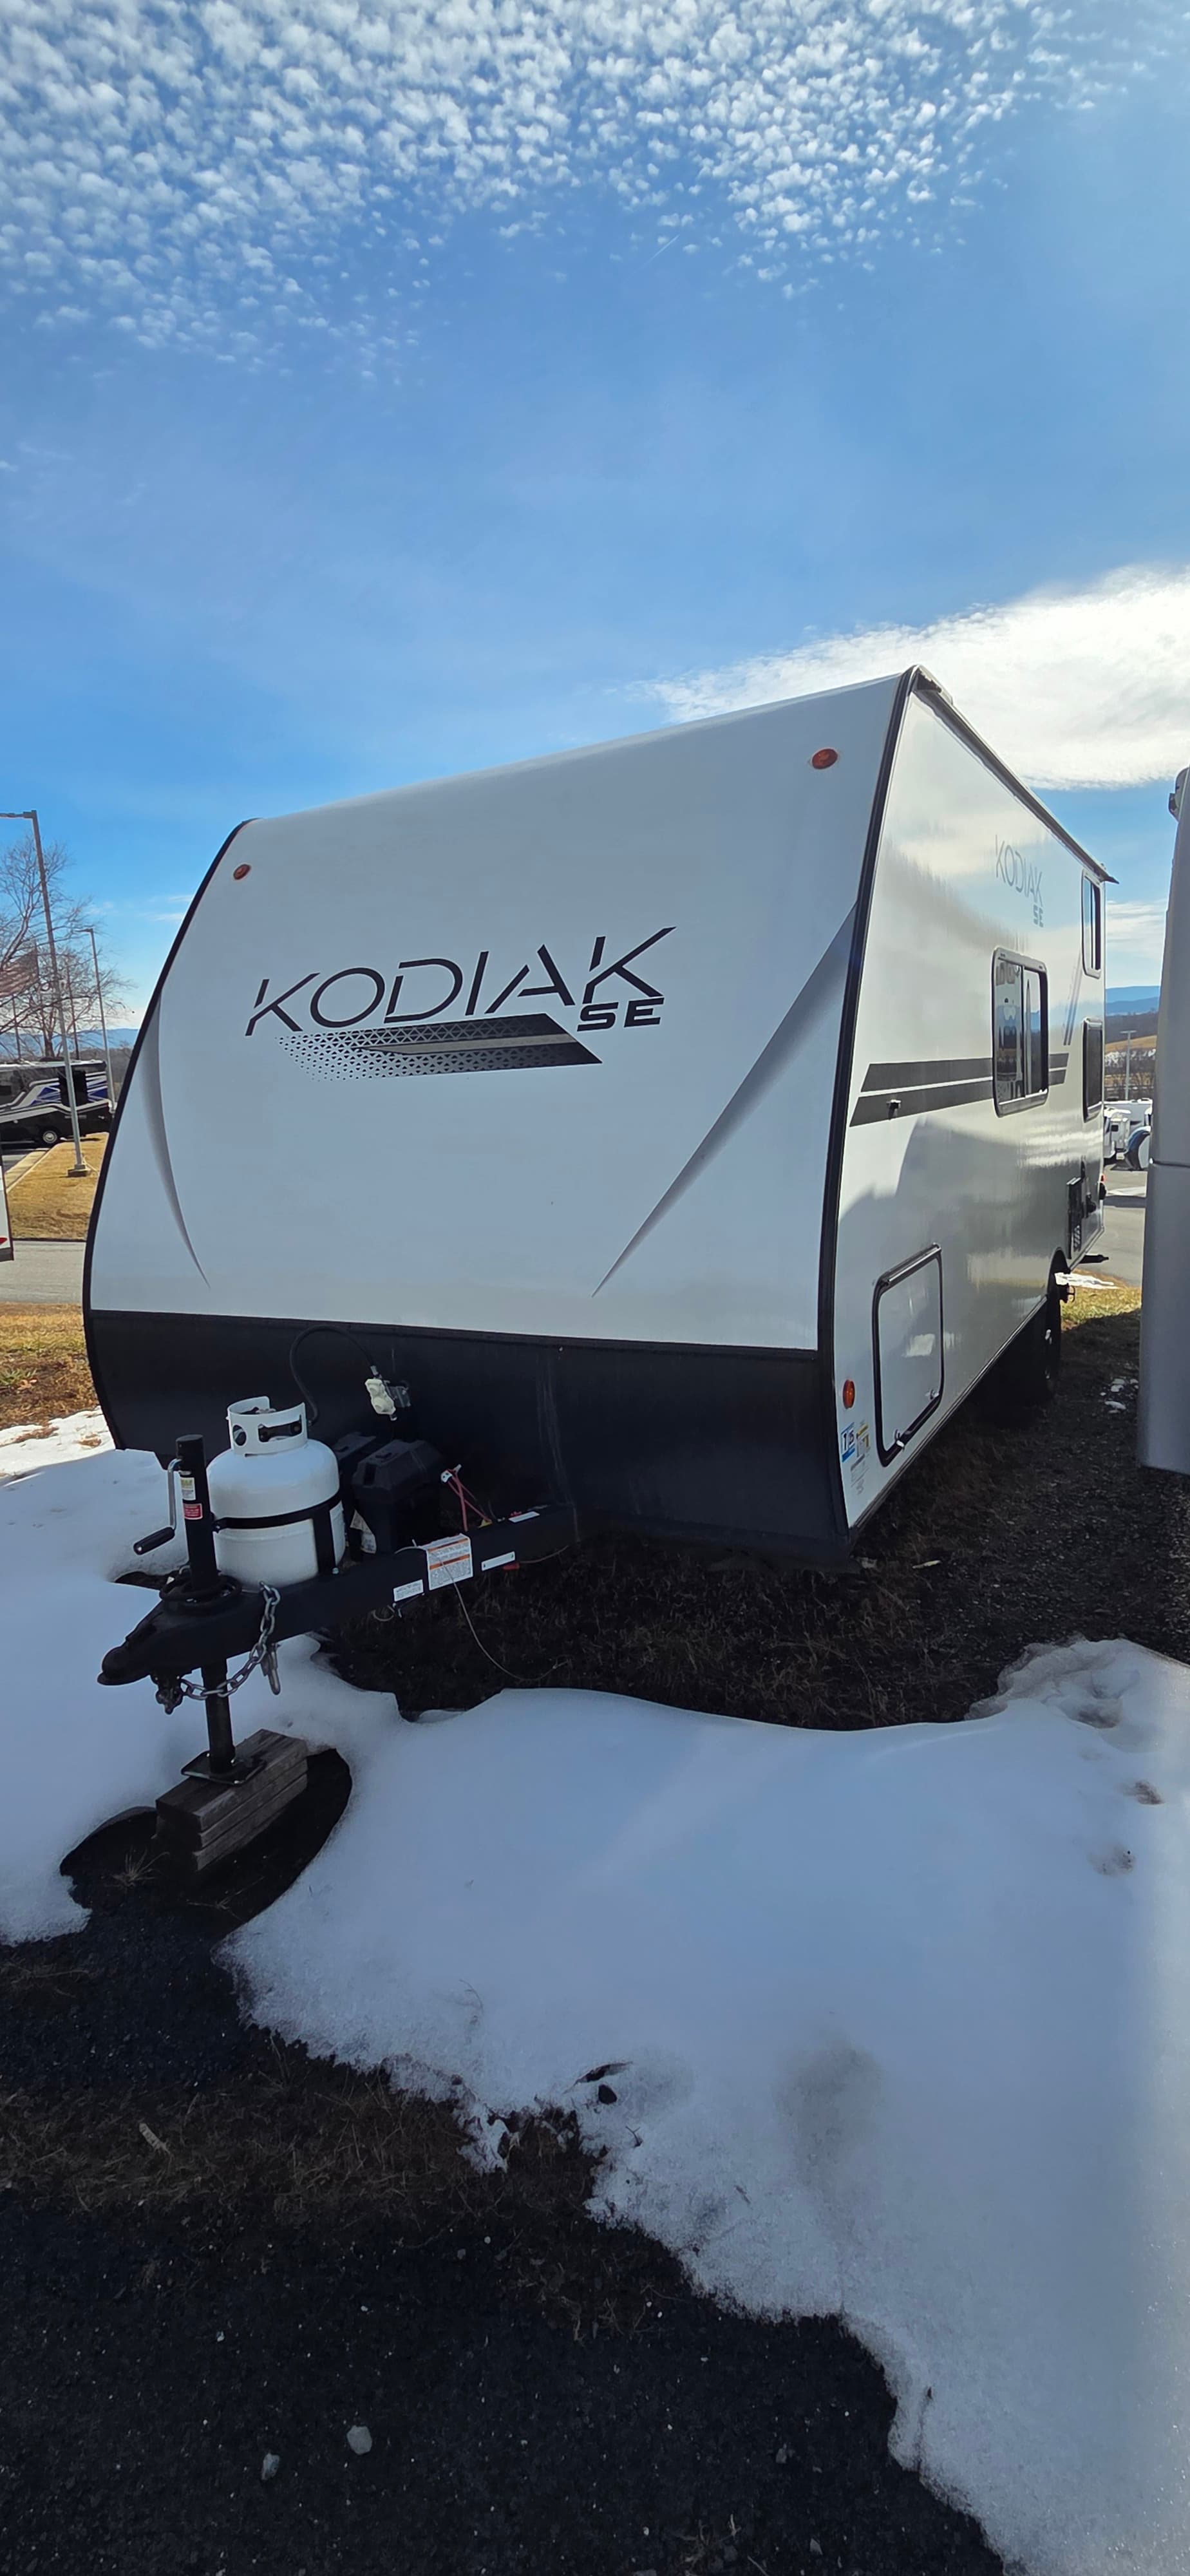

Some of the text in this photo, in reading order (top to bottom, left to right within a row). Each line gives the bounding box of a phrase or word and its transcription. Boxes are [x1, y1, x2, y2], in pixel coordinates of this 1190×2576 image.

[996, 835, 1043, 907] KODIAK
[1033, 904, 1044, 927] SE
[245, 926, 676, 1036] KODIAK
[577, 996, 664, 1032] SE
